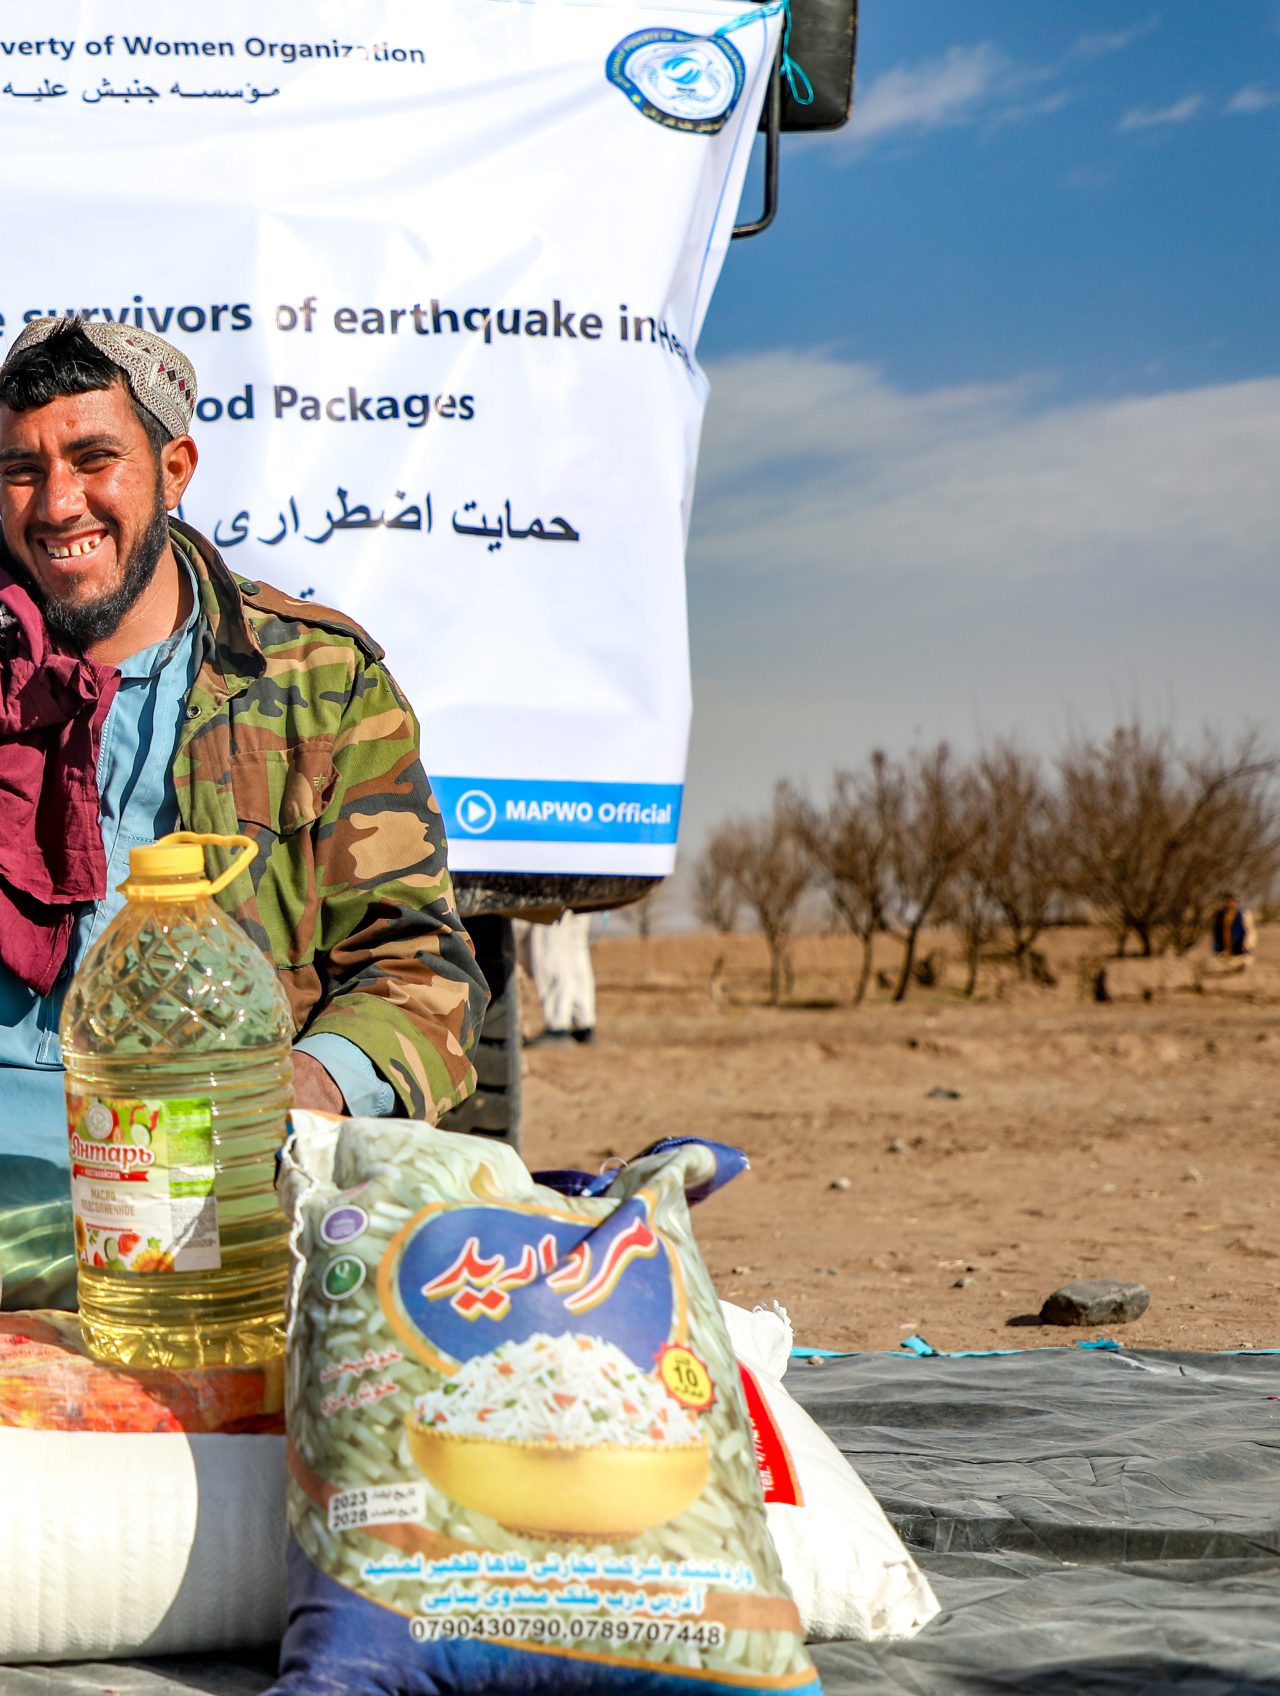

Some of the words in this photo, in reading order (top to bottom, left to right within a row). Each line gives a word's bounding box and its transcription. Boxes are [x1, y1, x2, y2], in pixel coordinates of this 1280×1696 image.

[85, 35, 115, 57] of
[123, 36, 235, 57] Women
[3, 78, 68, 102] علیه
[81, 78, 161, 104] جنبش
[275, 295, 318, 333] of
[333, 297, 604, 345] earthquake
[619, 303, 657, 343] in
[272, 383, 476, 428] Packages
[212, 485, 434, 548] اضطراری
[451, 497, 581, 553] حمایت
[505, 800, 593, 822] MAPWO
[598, 802, 671, 825] Official
[71, 1134, 155, 1174] Янтарь
[673, 1366, 699, 1388] 10
[332, 1490, 368, 1513] 2023
[602, 1556, 663, 1579] شرکت
[411, 1617, 721, 1646] 0790430790,0789707448
